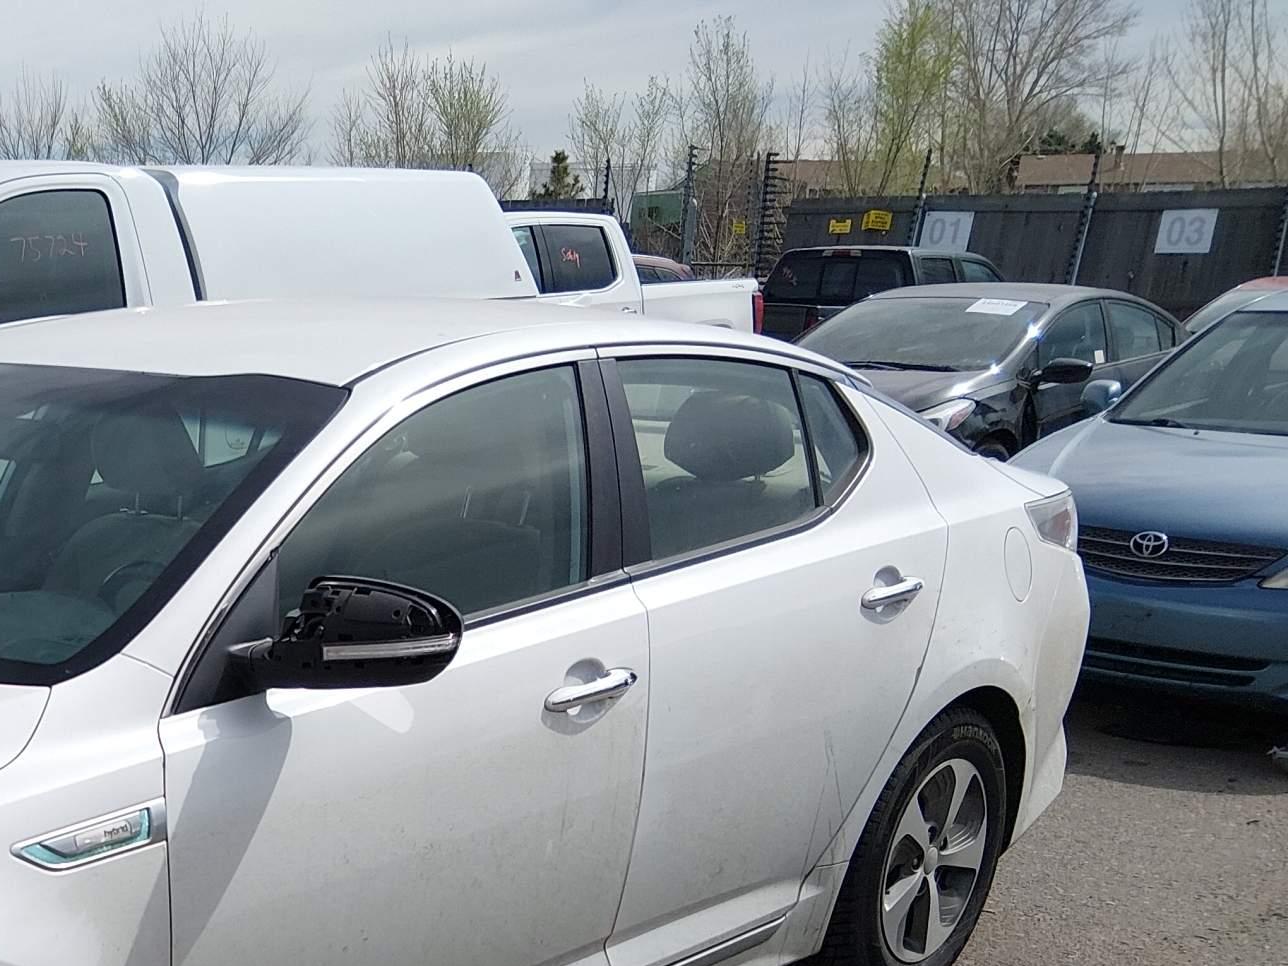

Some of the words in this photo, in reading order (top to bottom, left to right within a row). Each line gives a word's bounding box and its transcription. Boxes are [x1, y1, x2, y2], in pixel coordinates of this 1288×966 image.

[929, 218, 961, 245] 01
[1166, 215, 1206, 246] 03
[10, 232, 88, 264] 75724
[103, 823, 129, 840] hybrid
